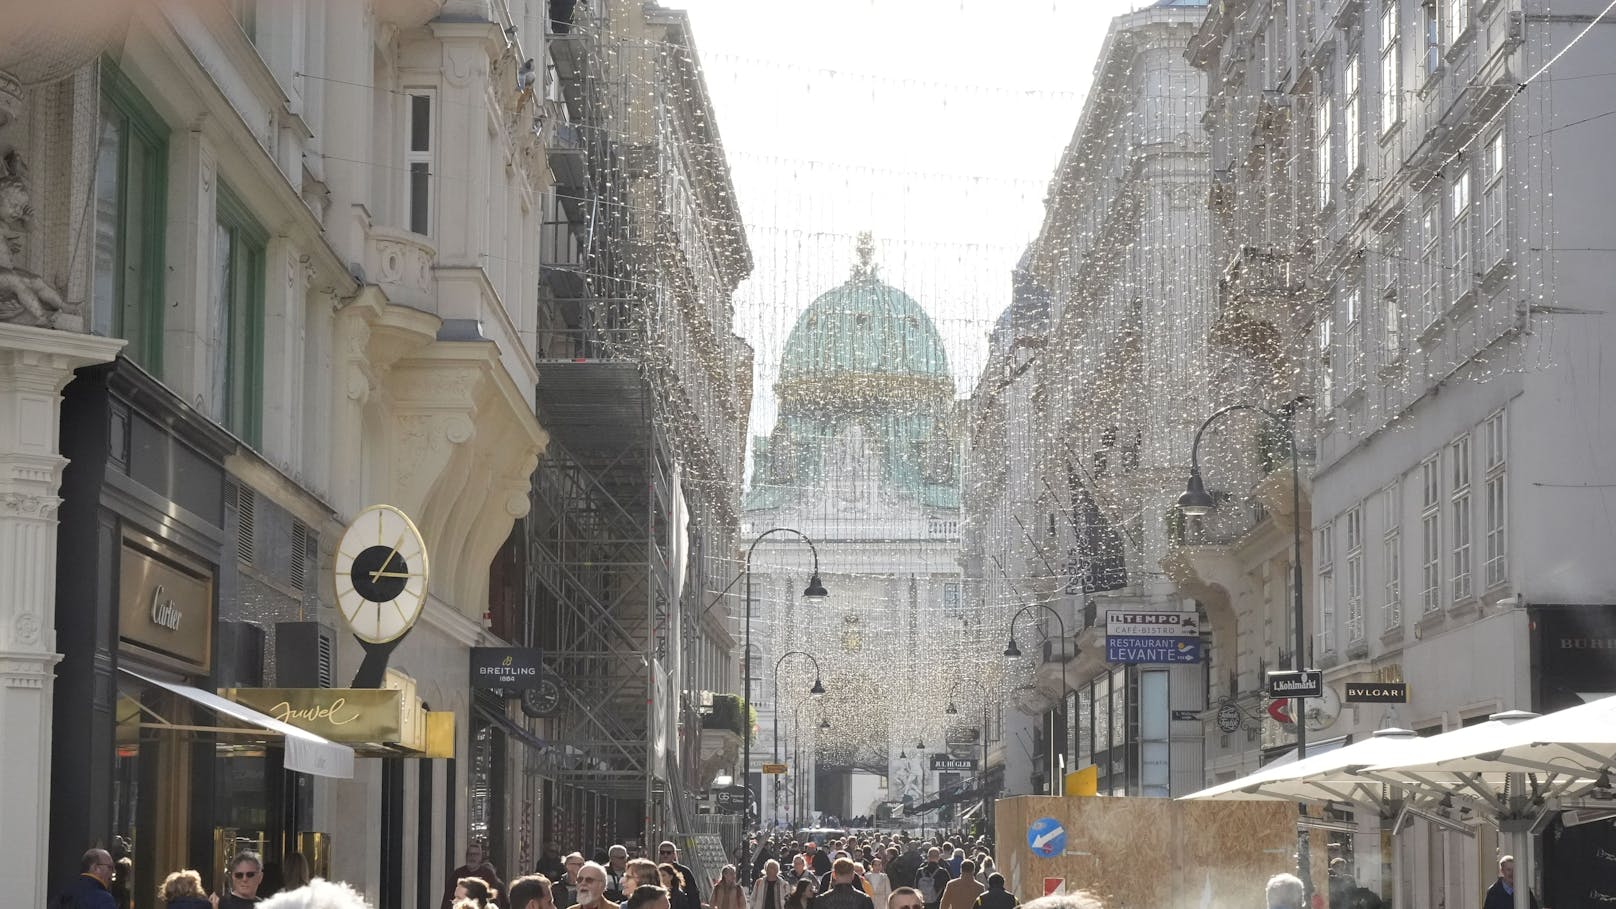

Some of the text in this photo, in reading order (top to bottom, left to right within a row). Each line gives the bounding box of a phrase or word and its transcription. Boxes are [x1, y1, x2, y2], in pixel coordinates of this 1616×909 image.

[153, 584, 182, 631] Cartier
[1124, 615, 1179, 623] TEMPO
[1110, 640, 1175, 648] RESTAURANT
[1110, 649, 1176, 661] LEVANTE
[479, 667, 536, 675] BREITLING
[270, 698, 360, 725] Juwel
